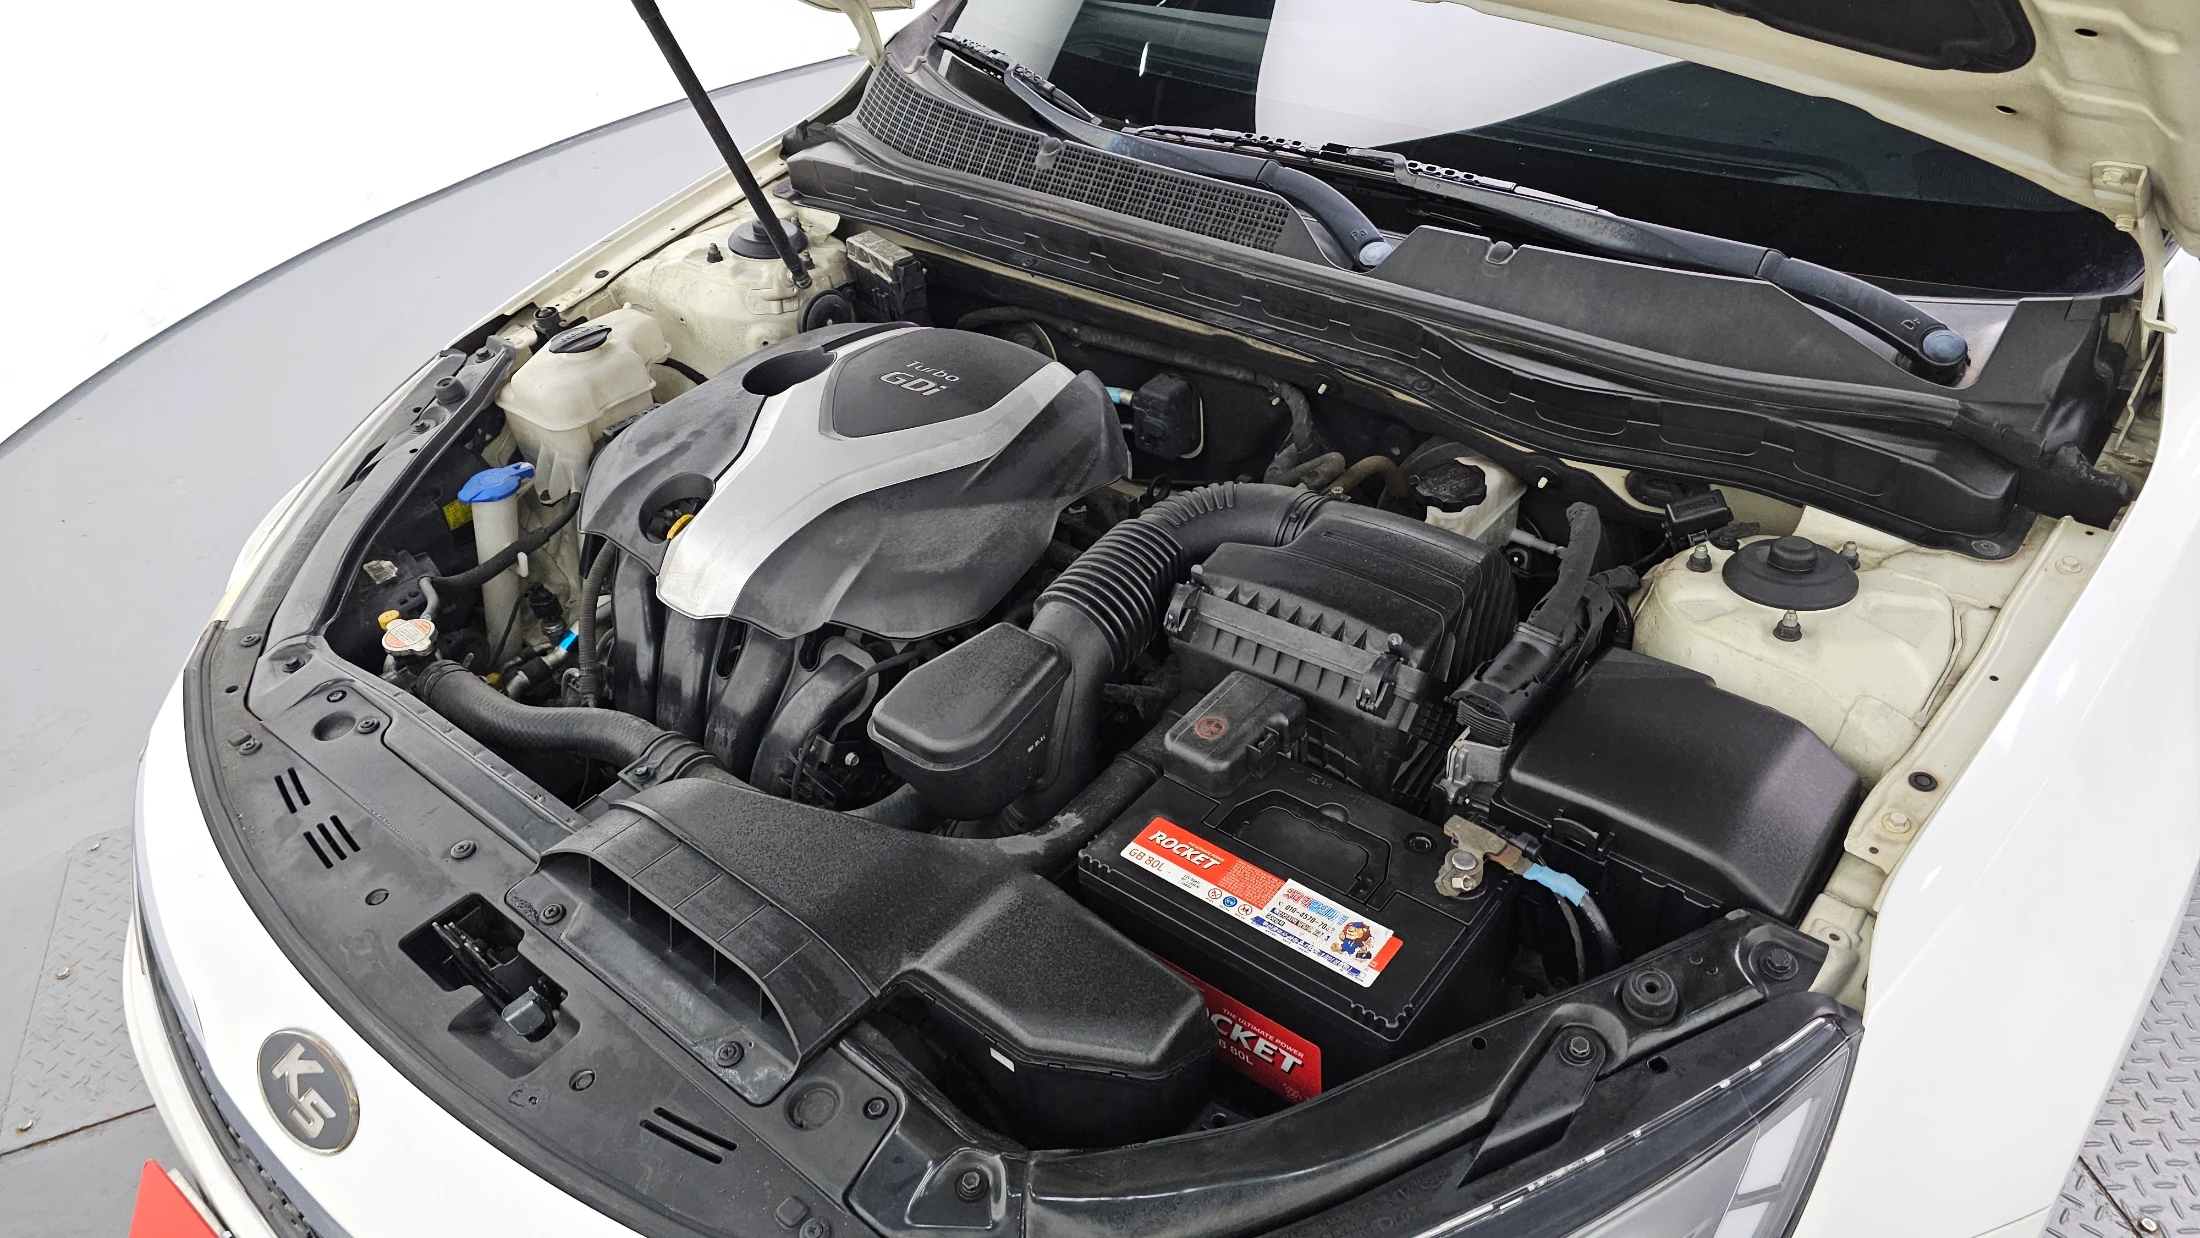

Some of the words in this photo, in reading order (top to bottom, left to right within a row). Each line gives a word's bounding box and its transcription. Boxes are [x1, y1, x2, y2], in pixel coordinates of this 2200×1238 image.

[880, 371, 948, 396] GDi
[906, 360, 960, 382] Turbo
[1129, 848, 1147, 861] GB
[1144, 855, 1165, 872] 80L
[1148, 830, 1222, 870] ROCKET
[1206, 1007, 1304, 1074] CKET
[1223, 1008, 1237, 1020] THE
[1238, 1017, 1275, 1042] ULTIMATE
[1275, 1038, 1305, 1059] POWER
[1230, 1045, 1254, 1066] 80L
[269, 1041, 337, 1139] K5
